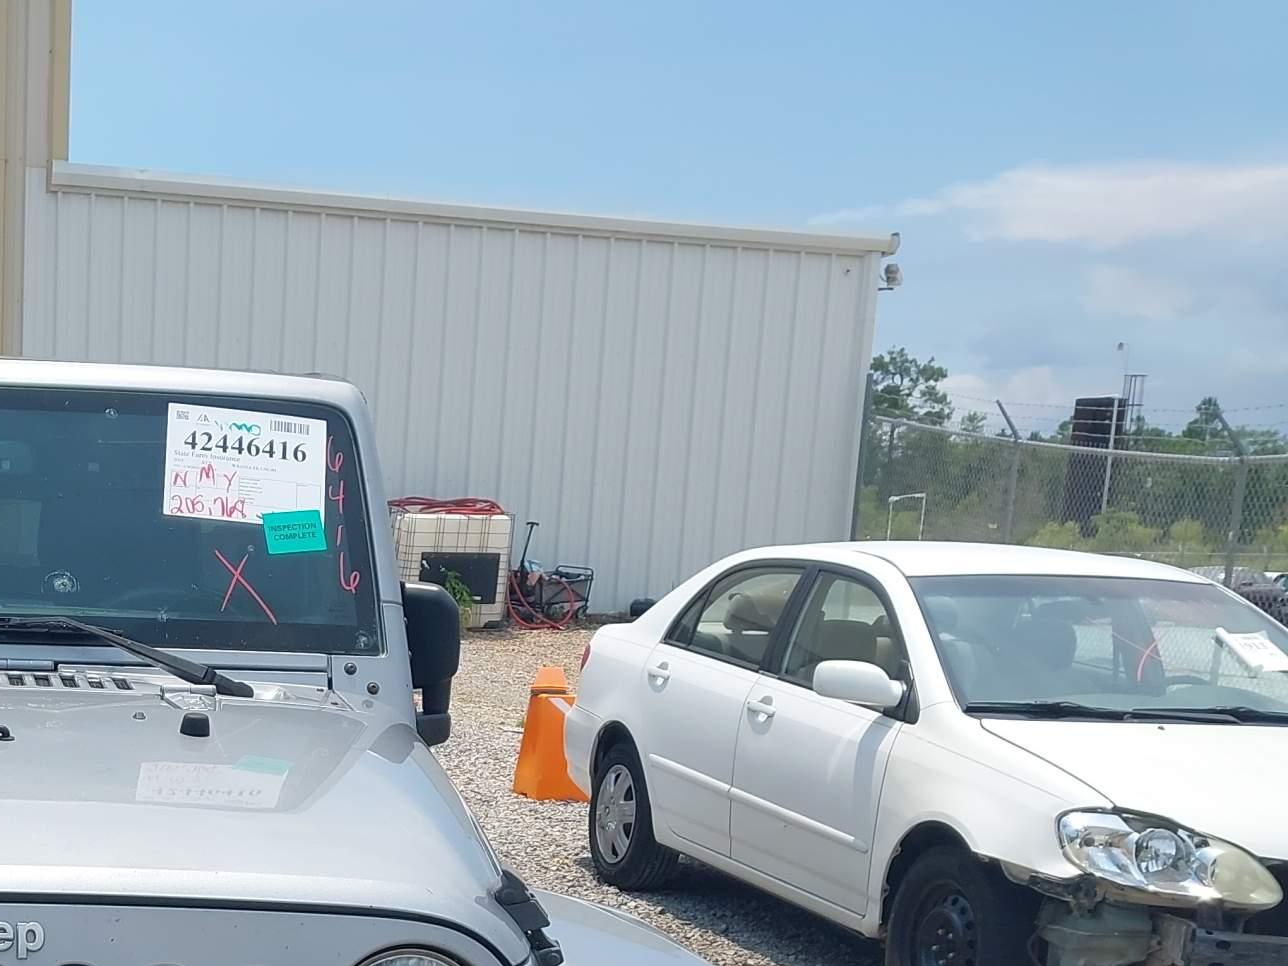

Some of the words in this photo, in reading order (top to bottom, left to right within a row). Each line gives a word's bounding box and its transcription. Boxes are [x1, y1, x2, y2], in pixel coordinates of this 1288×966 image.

[184, 430, 307, 463] 42446416
[268, 522, 317, 532] INSPECTION
[273, 532, 317, 541] COMPLETE
